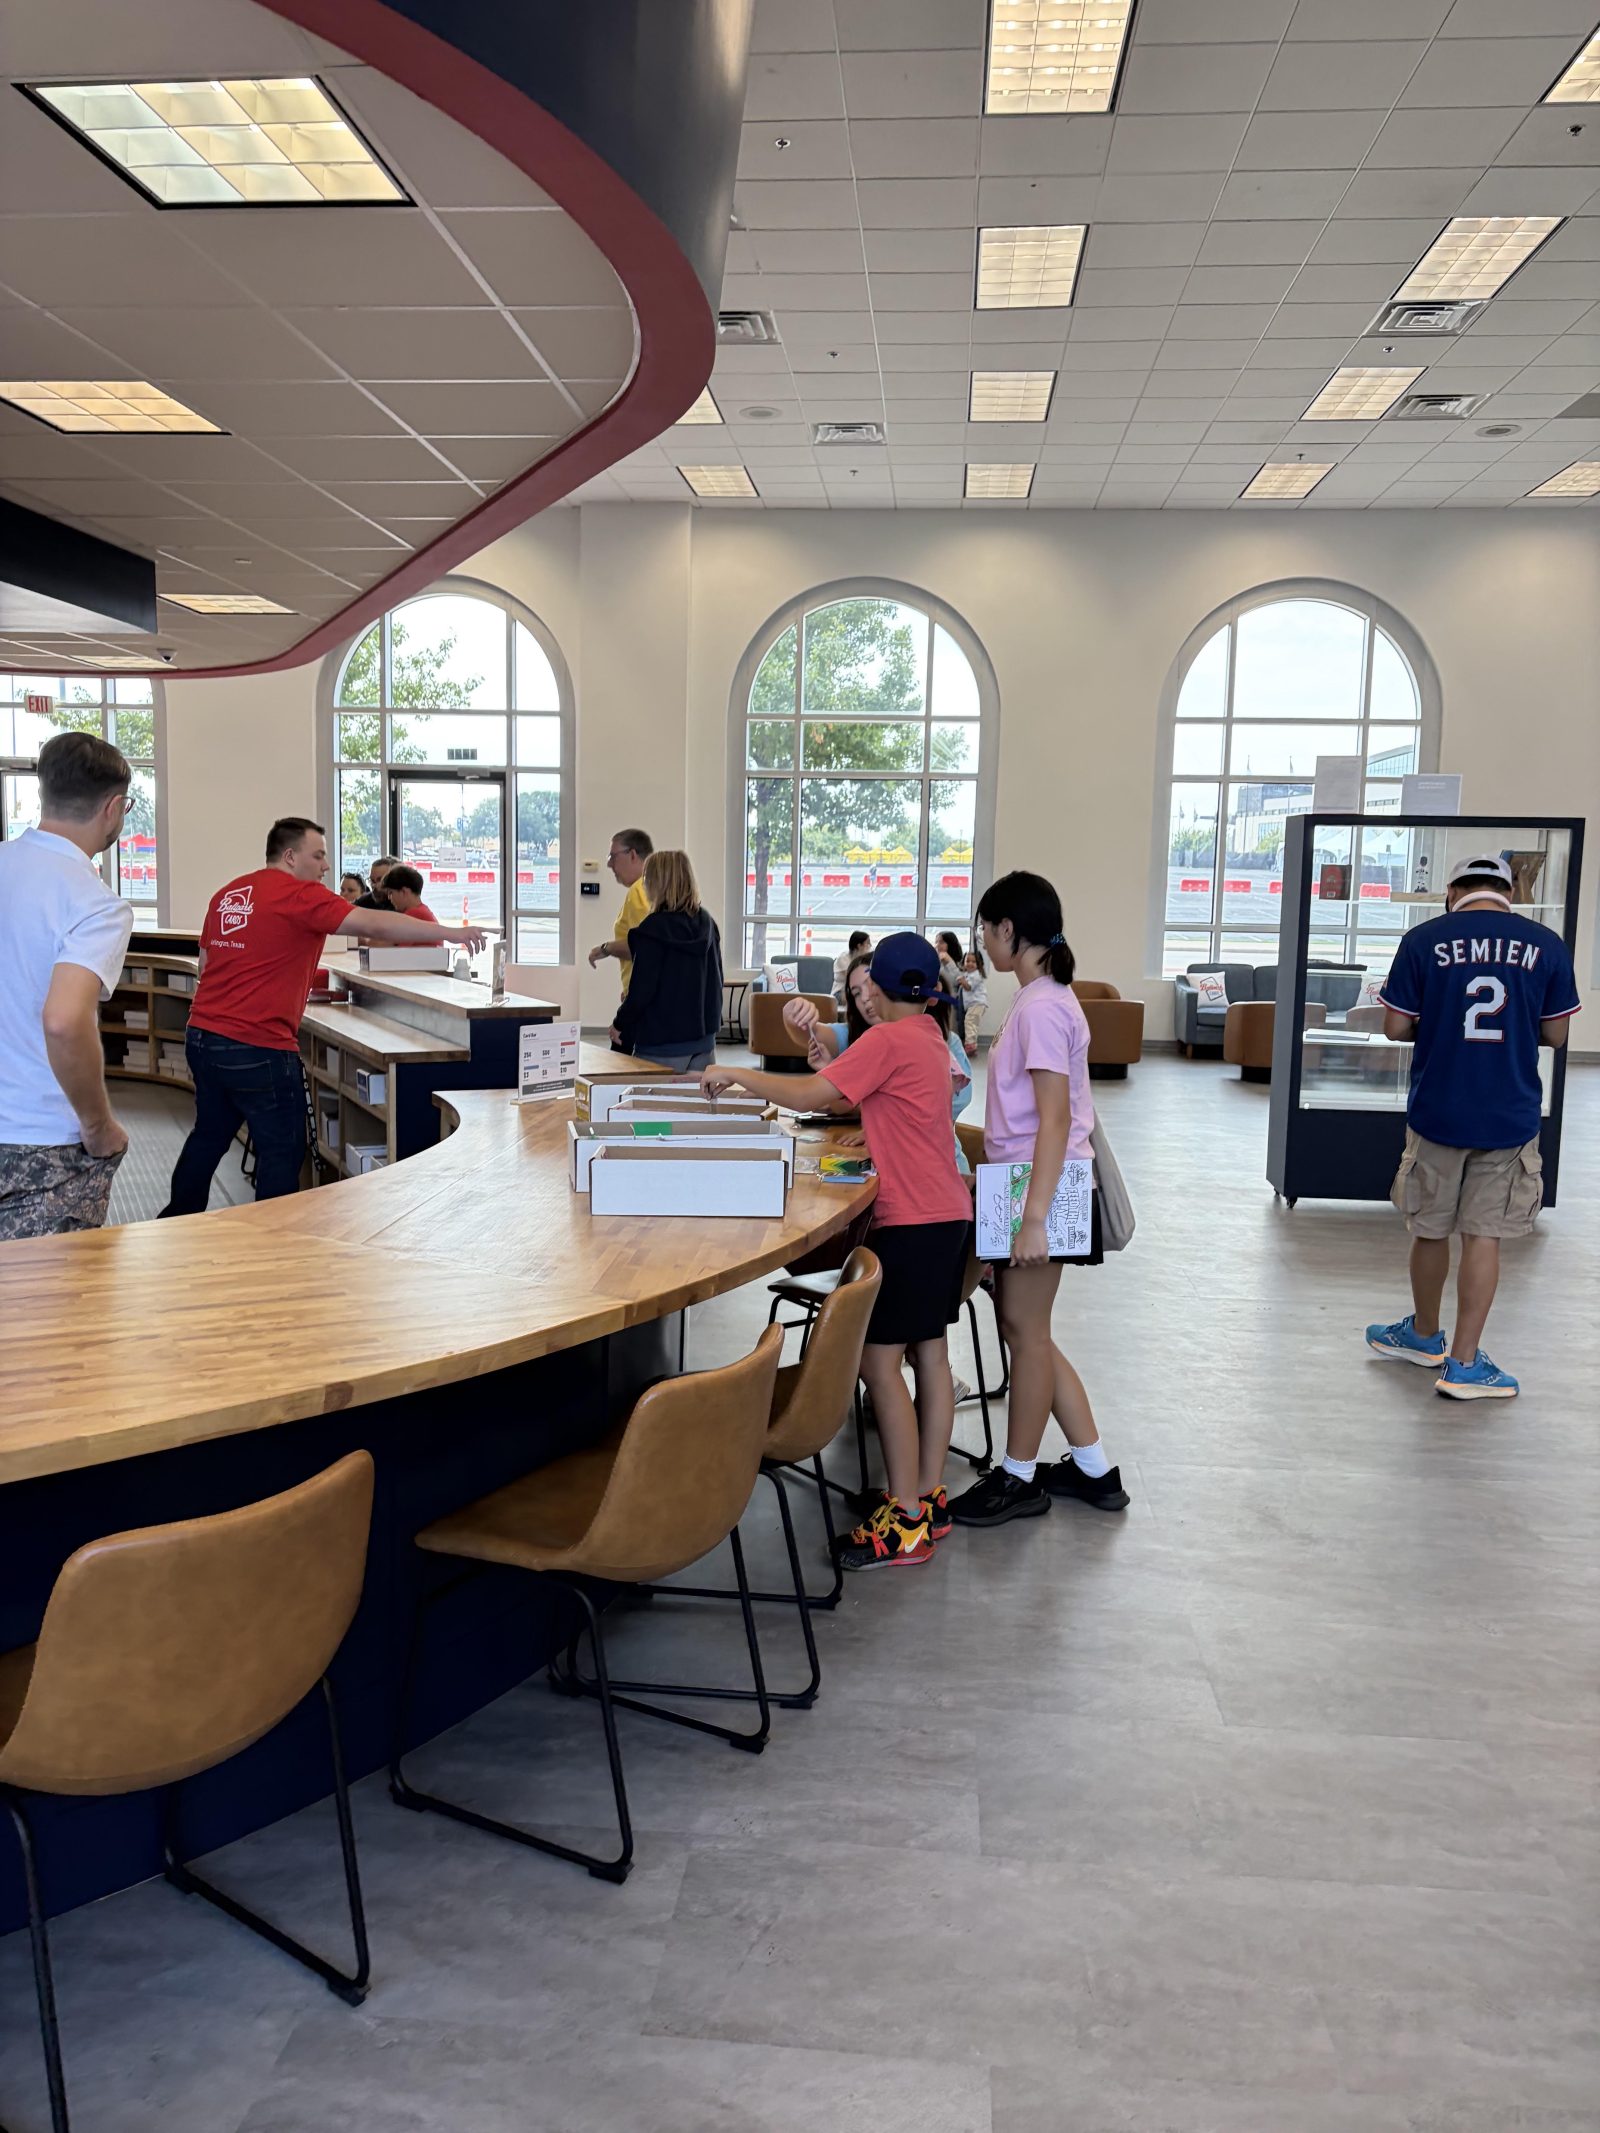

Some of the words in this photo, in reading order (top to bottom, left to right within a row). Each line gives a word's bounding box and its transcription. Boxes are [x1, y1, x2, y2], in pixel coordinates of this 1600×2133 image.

[28, 695, 48, 713] EXIT
[216, 897, 254, 915] Ballpark
[231, 941, 245, 949] Texas
[1434, 938, 1541, 972] SEMIEN
[1463, 976, 1508, 1042] 2
